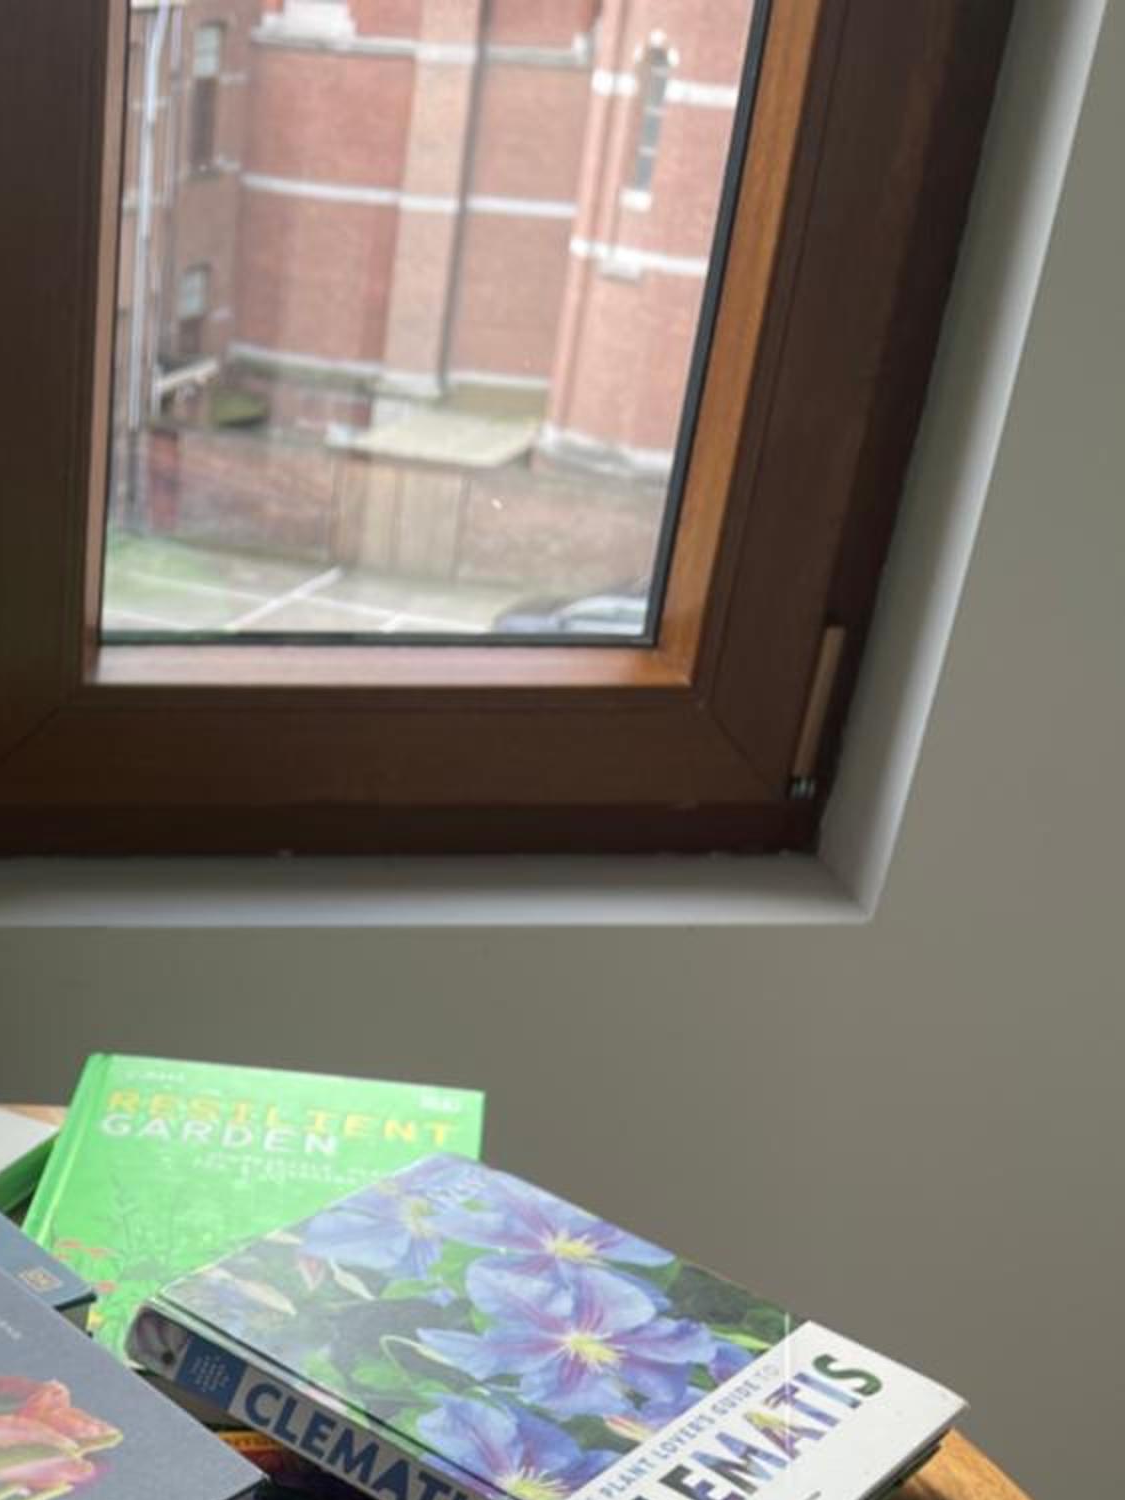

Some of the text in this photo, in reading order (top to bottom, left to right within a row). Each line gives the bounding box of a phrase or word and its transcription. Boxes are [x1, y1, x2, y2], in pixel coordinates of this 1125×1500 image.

[100, 1113, 339, 1156] GARDEN
[105, 1087, 458, 1147] RESILIENT
[599, 1456, 655, 1500] PLANT
[711, 1379, 761, 1419] GUIDE
